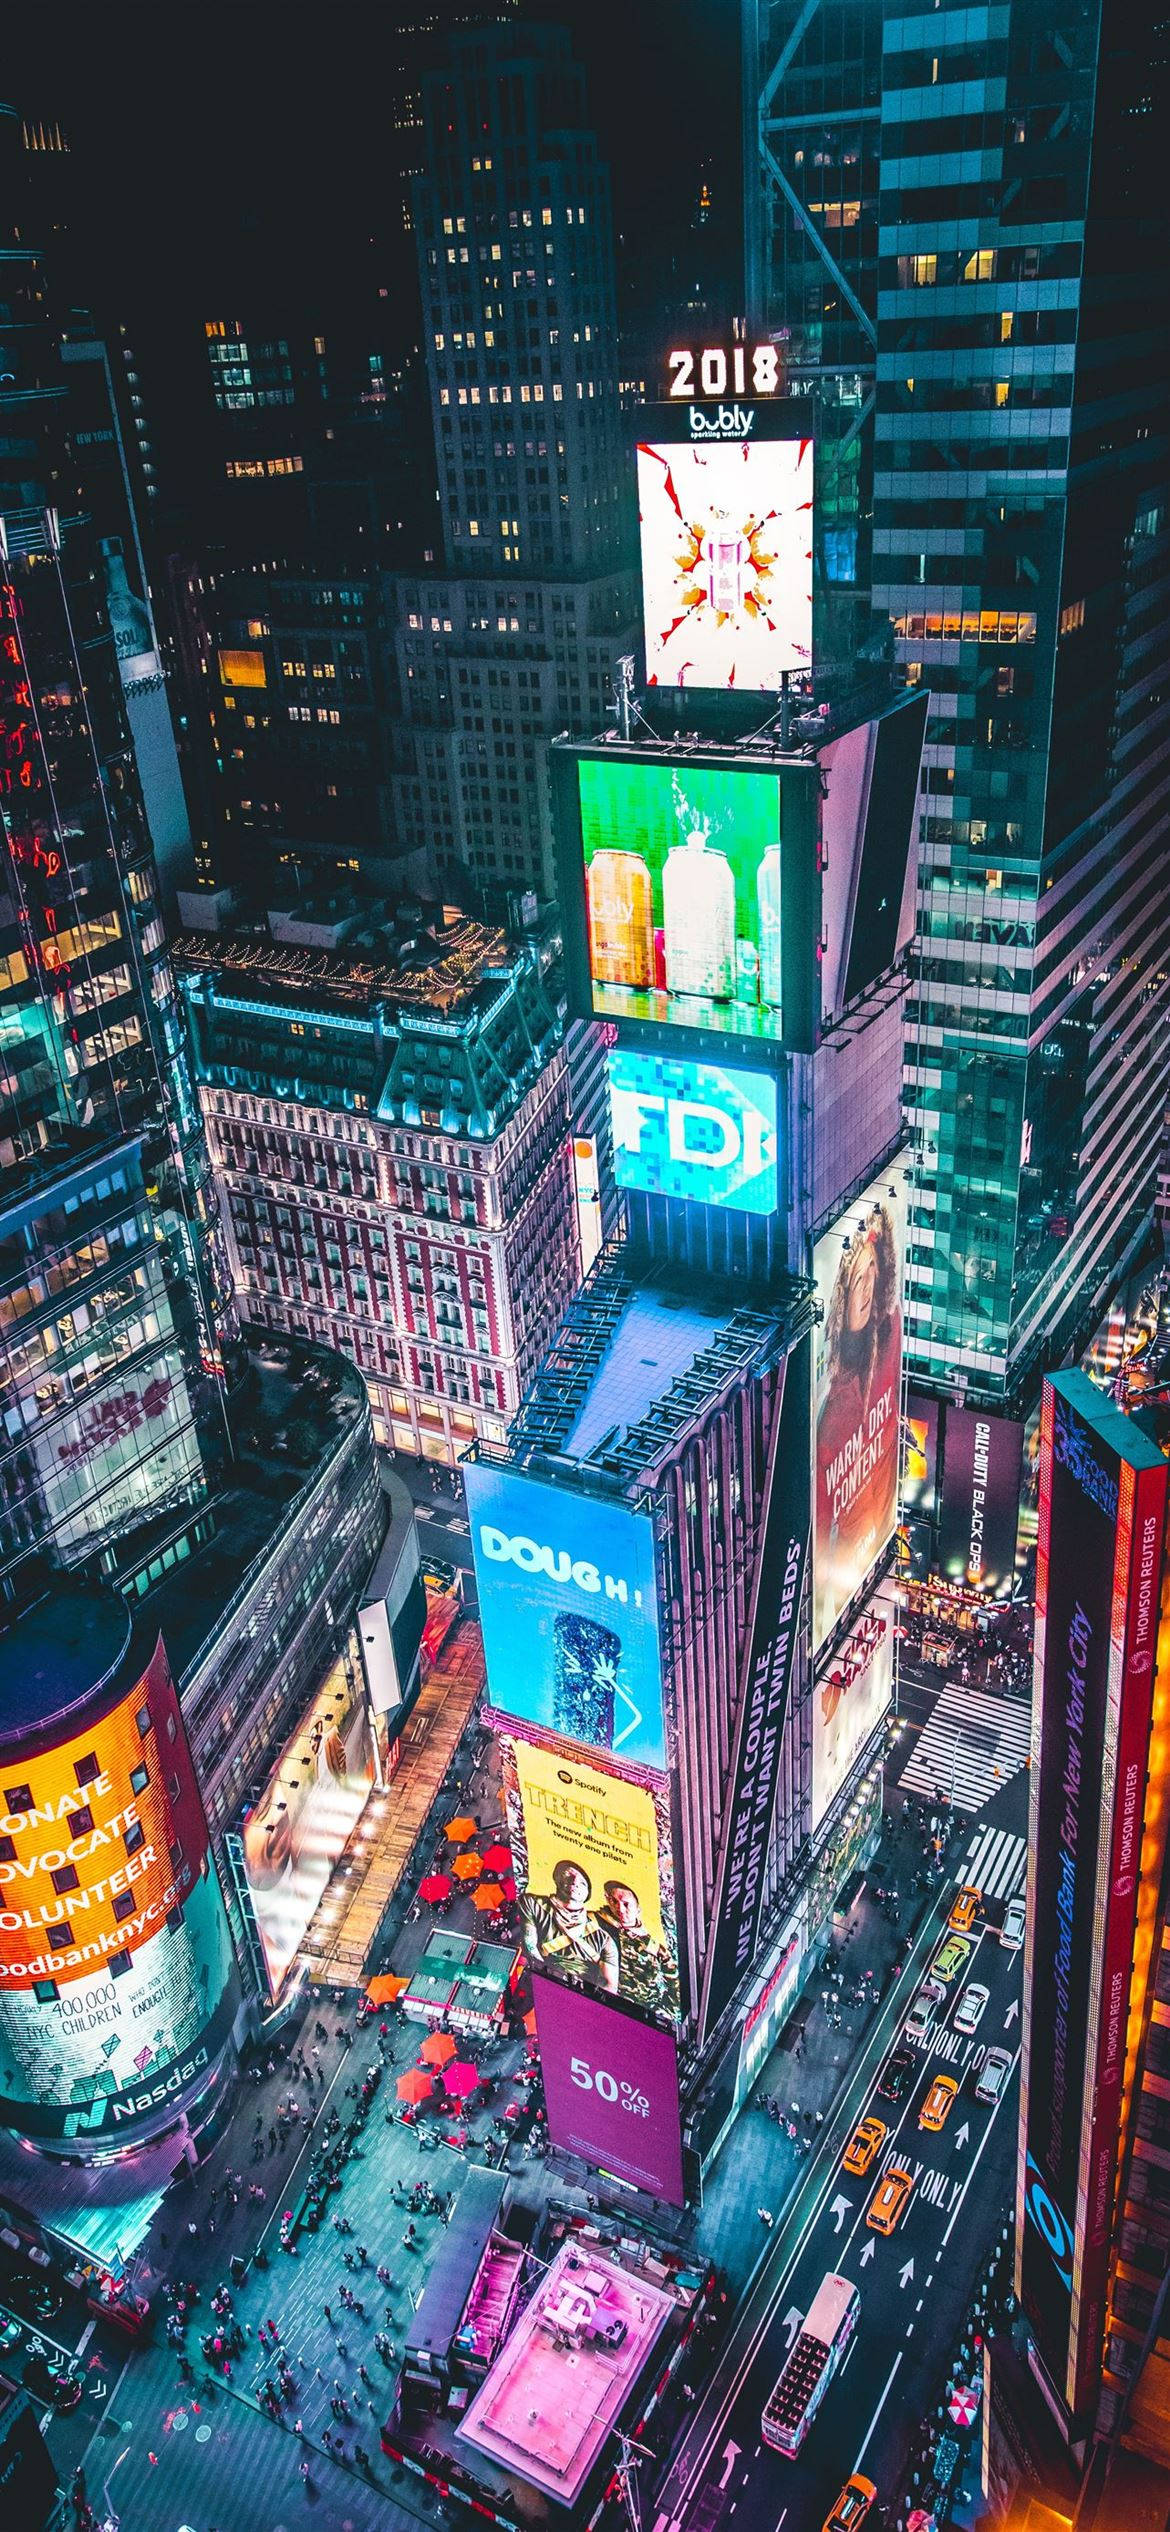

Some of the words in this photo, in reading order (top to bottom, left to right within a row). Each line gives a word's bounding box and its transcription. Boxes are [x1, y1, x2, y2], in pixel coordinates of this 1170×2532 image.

[669, 345, 779, 396] 2018
[690, 404, 754, 436] bubly
[825, 1423, 866, 1497] WARM.
[868, 1386, 893, 1438] DRY.
[975, 1422, 990, 1450] CALL
[833, 1428, 885, 1519] CONTENT.
[973, 1451, 989, 1487] DUTY
[970, 1489, 985, 1541] BLACK
[968, 1543, 984, 1572] OPS
[1140, 1516, 1157, 1578] REUTERS
[1069, 1600, 1093, 1669] City
[1135, 1579, 1152, 1645] THOMSON
[767, 1630, 790, 1717] TWIN
[744, 1640, 773, 1773] COUPLE.
[1066, 1666, 1087, 1737] York
[574, 1778, 608, 1798] Spotify
[740, 1776, 755, 1800] A
[754, 1725, 778, 1817] WANT
[1063, 1735, 1082, 1808] New
[1124, 1763, 1138, 1813] REUTERS
[524, 1781, 652, 1853] TRENCH
[545, 1817, 562, 1831] The
[563, 1825, 583, 1838] new
[583, 1832, 611, 1850] album
[612, 1845, 634, 1860] from
[553, 1830, 584, 1849] twenty
[1060, 1804, 1080, 1856] For
[1119, 1813, 1133, 1872] THOMSON
[741, 1821, 765, 1914] DON'T
[1057, 1850, 1077, 1923] Bank
[735, 1915, 753, 1969] WE
[1054, 1910, 1073, 1986] Food
[52, 1983, 117, 2019] 400,000
[1053, 1971, 1070, 2013] of
[1109, 1971, 1123, 2016] REUTERS
[62, 2002, 123, 2037] CHILDREN
[1106, 2017, 1119, 2064] THOMSON
[936, 2031, 976, 2067] ONLY
[112, 2046, 209, 2121] Nasdaq
[570, 2056, 650, 2109] 50%
[621, 2099, 650, 2119] OFF
[920, 2169, 963, 2213] ONLY
